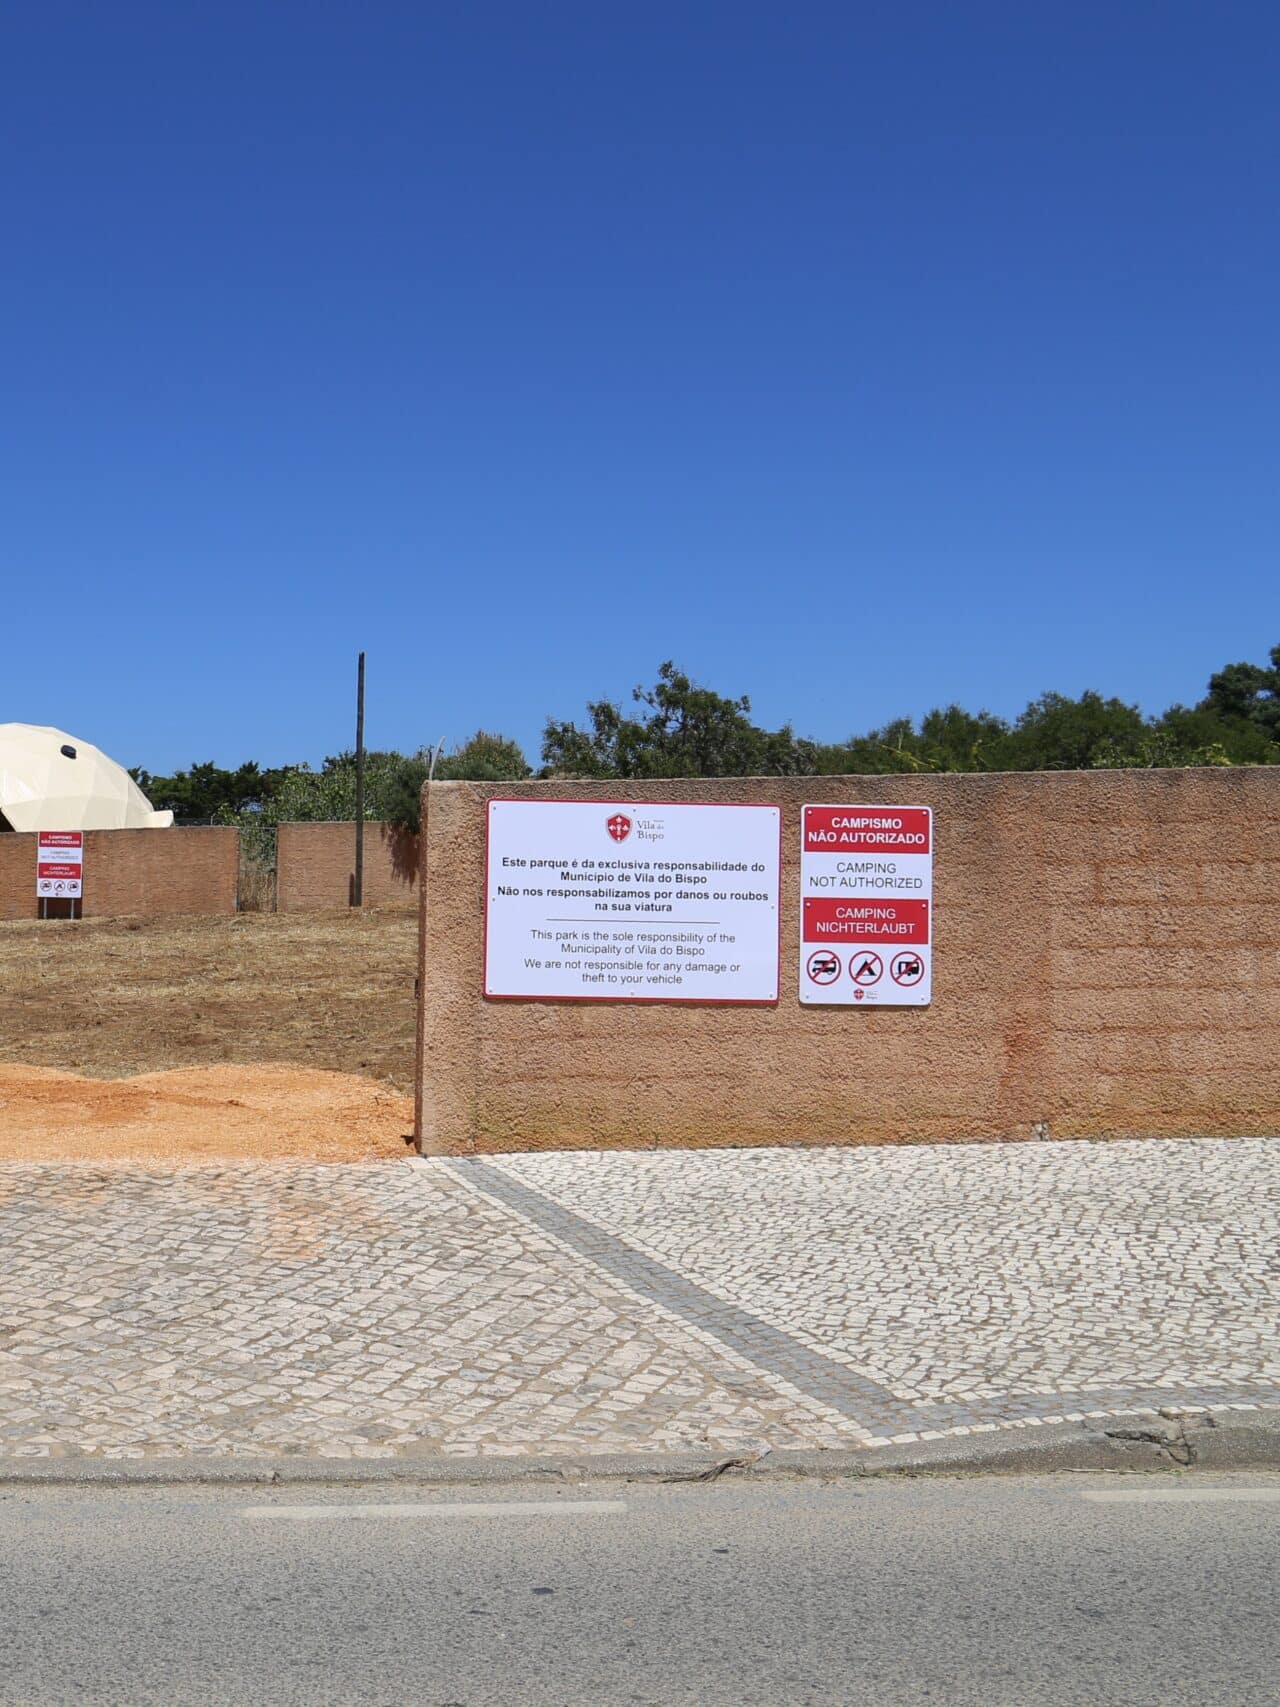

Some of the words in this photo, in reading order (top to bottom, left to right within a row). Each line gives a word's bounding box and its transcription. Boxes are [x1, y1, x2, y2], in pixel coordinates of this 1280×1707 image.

[636, 820, 655, 830] Vila
[831, 817, 903, 830] CAMPISMO
[636, 830, 665, 843] Bispo
[808, 829, 838, 843] NÃO
[839, 832, 926, 845] AUTORIZADO
[501, 857, 527, 868] Este
[529, 860, 570, 873] parque
[571, 858, 579, 869] é
[581, 859, 596, 870] da
[597, 859, 651, 871] exclusiva
[653, 861, 748, 875] responsabilidade
[750, 862, 767, 873] do
[836, 861, 897, 874] CAMPING
[617, 873, 632, 883] de
[633, 873, 655, 883] Vila
[657, 873, 672, 883] do
[675, 874, 708, 886] Bispo
[809, 876, 836, 888] NOT
[839, 876, 923, 889] AUTHORIZED
[497, 886, 520, 897] Não
[522, 888, 544, 897] nos
[546, 887, 651, 900] responsabilizamos
[653, 891, 673, 902] por
[675, 889, 710, 900] danos
[712, 892, 727, 901] ou
[729, 891, 770, 902] roubos
[594, 902, 609, 911] na
[611, 903, 632, 912] sua
[633, 901, 673, 913] viatura
[835, 907, 897, 920] CAMPING
[816, 922, 916, 934] NICHTERLAUBT
[530, 929, 553, 940] This
[555, 930, 579, 942] park
[581, 931, 590, 941] is
[592, 931, 610, 942] the
[612, 931, 634, 942] sole
[636, 932, 704, 945] responsibility
[706, 932, 718, 943] of
[719, 933, 736, 944] the
[561, 943, 622, 956] Municipality
[624, 944, 636, 955] of
[637, 944, 657, 955] Vila
[659, 945, 673, 956] do
[675, 945, 706, 958] Bispo
[523, 958, 542, 969] We
[544, 960, 562, 969] are
[564, 959, 582, 970] not
[583, 959, 644, 972] responsible
[646, 961, 661, 971] for
[662, 963, 682, 974] any
[684, 962, 728, 975] damage
[729, 964, 741, 973] or
[581, 972, 605, 983] theft
[607, 973, 618, 984] to
[620, 975, 644, 986] your
[646, 972, 683, 985] vehicle
